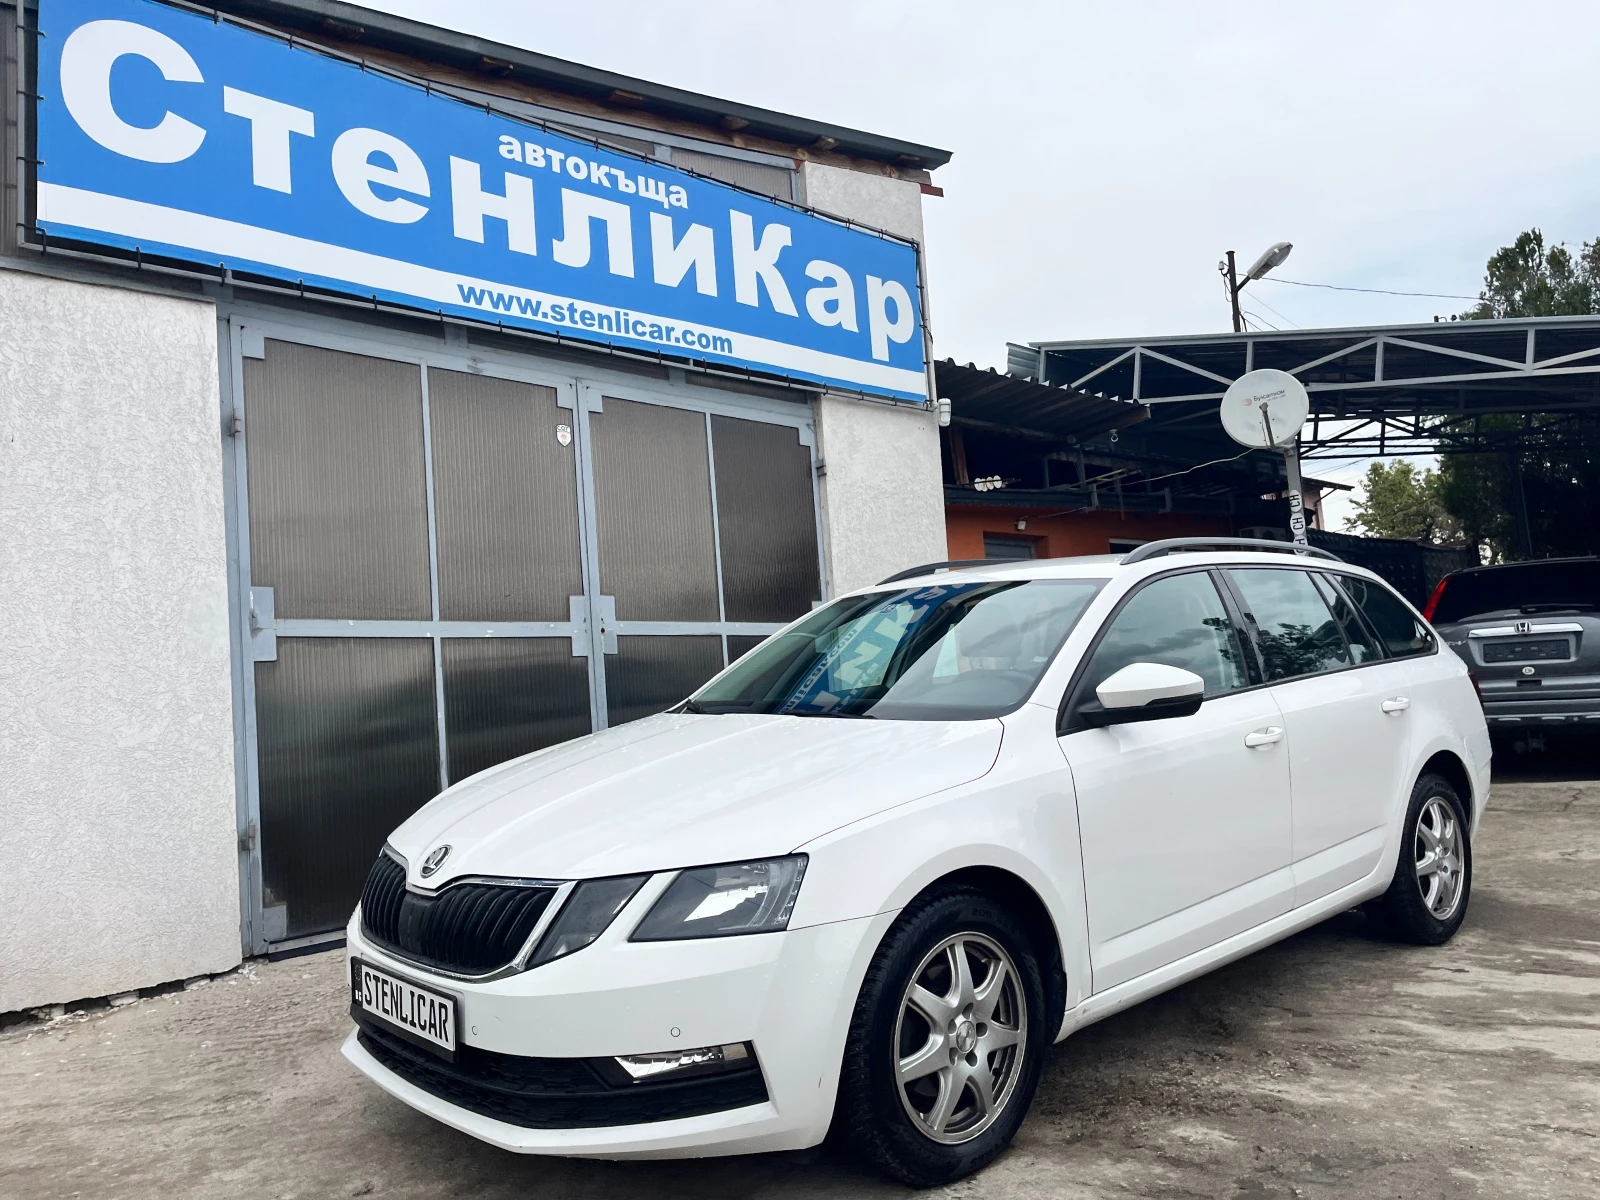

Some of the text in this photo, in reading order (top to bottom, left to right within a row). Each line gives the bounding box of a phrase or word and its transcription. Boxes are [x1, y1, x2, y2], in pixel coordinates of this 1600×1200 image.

[59, 19, 915, 362] СтенлиКар
[498, 135, 689, 210] автокъща
[457, 283, 733, 354] www.stenlicar.com
[1292, 517, 1304, 530] CH
[364, 971, 449, 1043] STENLICAR
